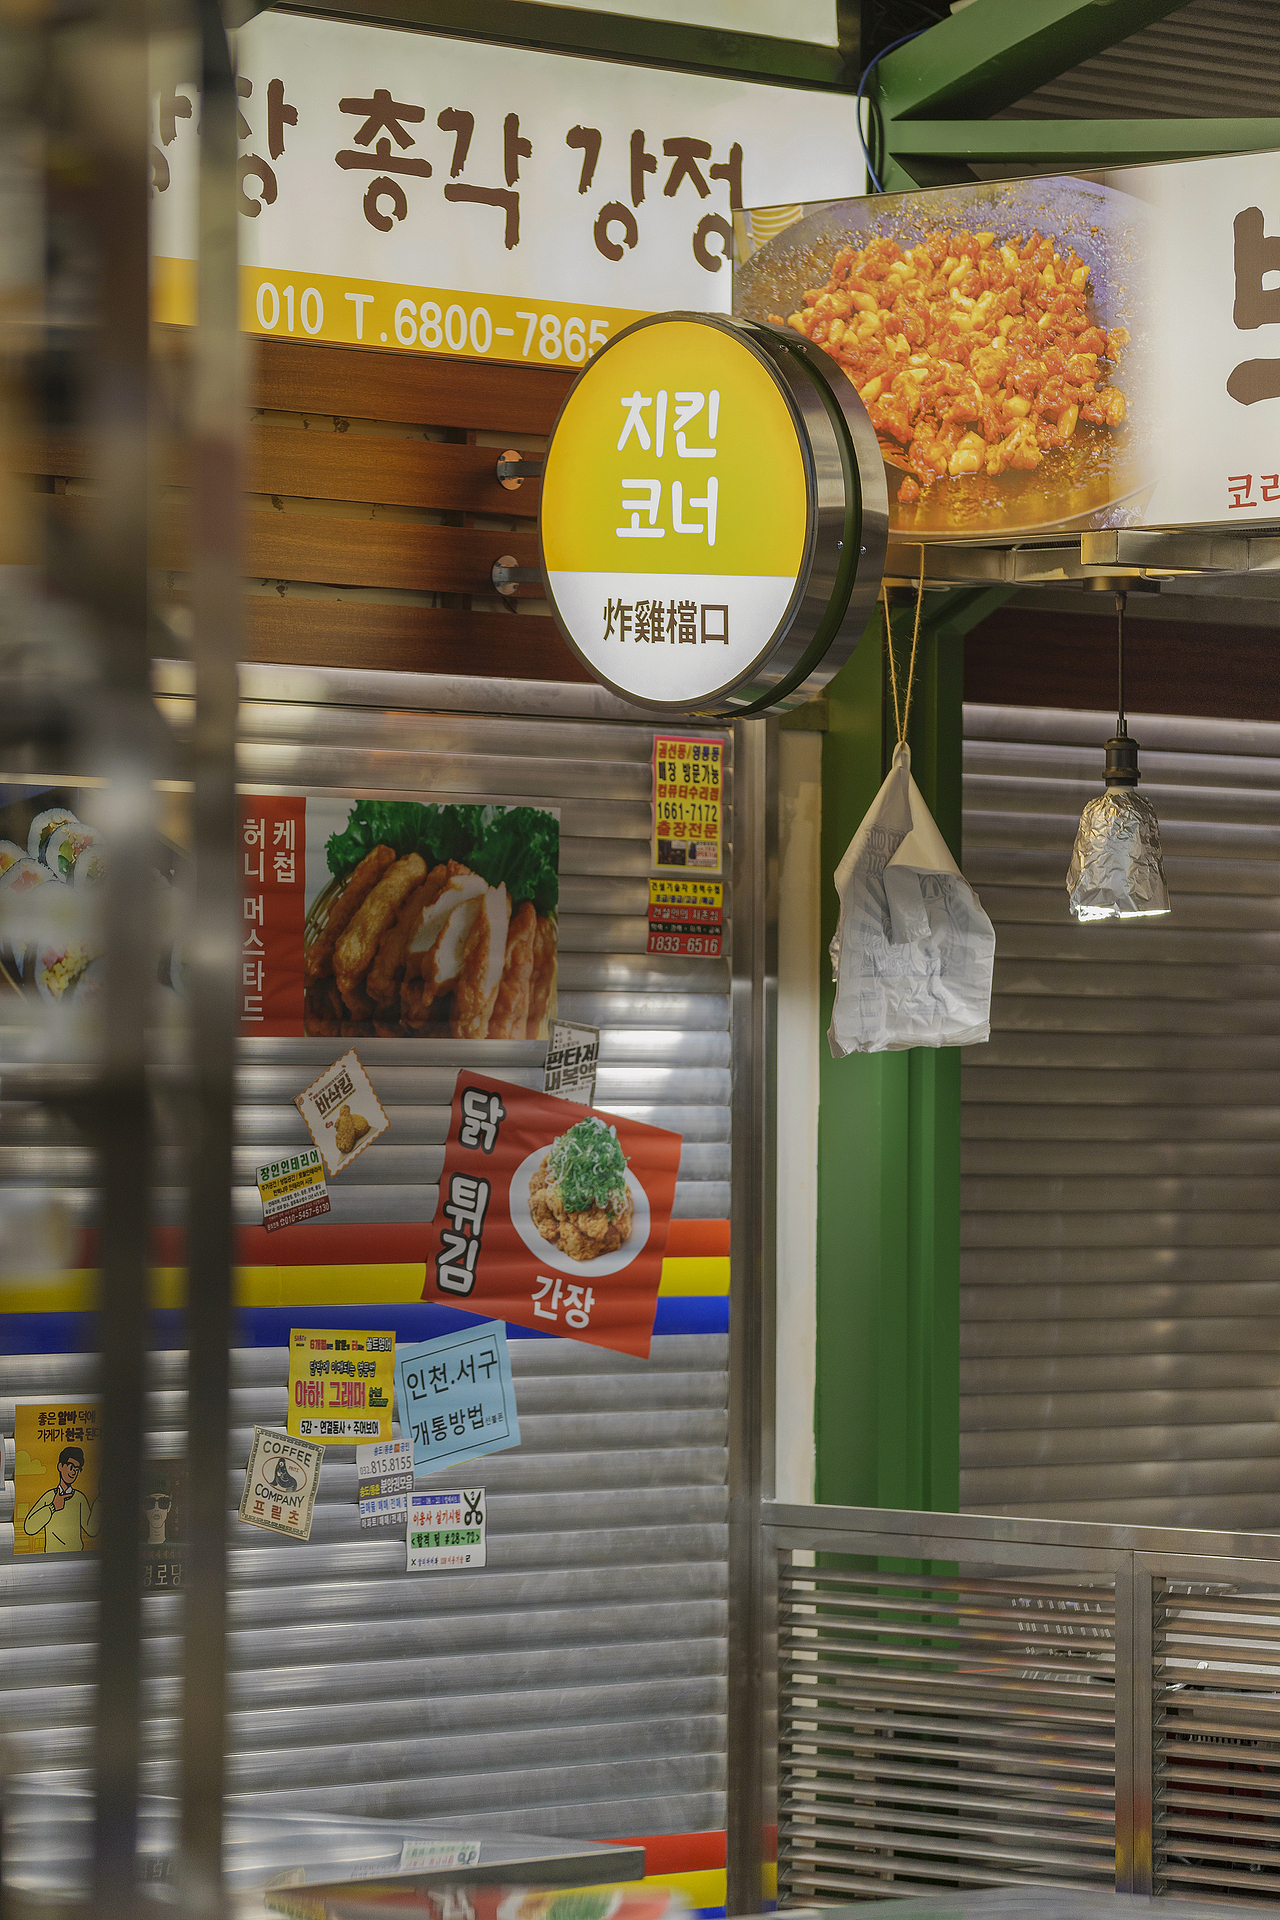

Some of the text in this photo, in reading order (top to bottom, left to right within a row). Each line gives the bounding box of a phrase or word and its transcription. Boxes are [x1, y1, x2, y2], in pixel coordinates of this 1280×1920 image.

[335, 89, 533, 250] 총각
[566, 125, 742, 272] 강정
[256, 282, 324, 334] 010
[617, 389, 720, 458] 치킨
[616, 476, 719, 546] 코너
[603, 598, 729, 645] 炸雞檔口
[682, 763, 719, 784] 방문가능
[656, 820, 718, 839] 출장전문
[658, 801, 718, 822] 1661-7172
[273, 819, 296, 883] 케첩
[241, 818, 266, 1021] 허니 머스타드
[650, 935, 719, 954] 1833-6516
[314, 1073, 354, 1116] 바삭킹
[260, 1149, 320, 1181] 장인인테리어
[435, 1087, 506, 1296] 닭 튀김
[531, 1275, 596, 1329] 간장
[406, 1350, 498, 1400] 인천.서구
[295, 1380, 366, 1409] 아하! 그래머
[37, 1428, 64, 1442] 가게가
[38, 1412, 56, 1426] 좋은
[57, 1410, 77, 1426] 알바
[320, 1420, 345, 1434] 연결동사
[412, 1403, 484, 1446] 개통방법
[262, 1440, 312, 1468] COFFEE
[255, 1483, 305, 1508] COMPANY
[435, 1508, 461, 1525] 실기시험
